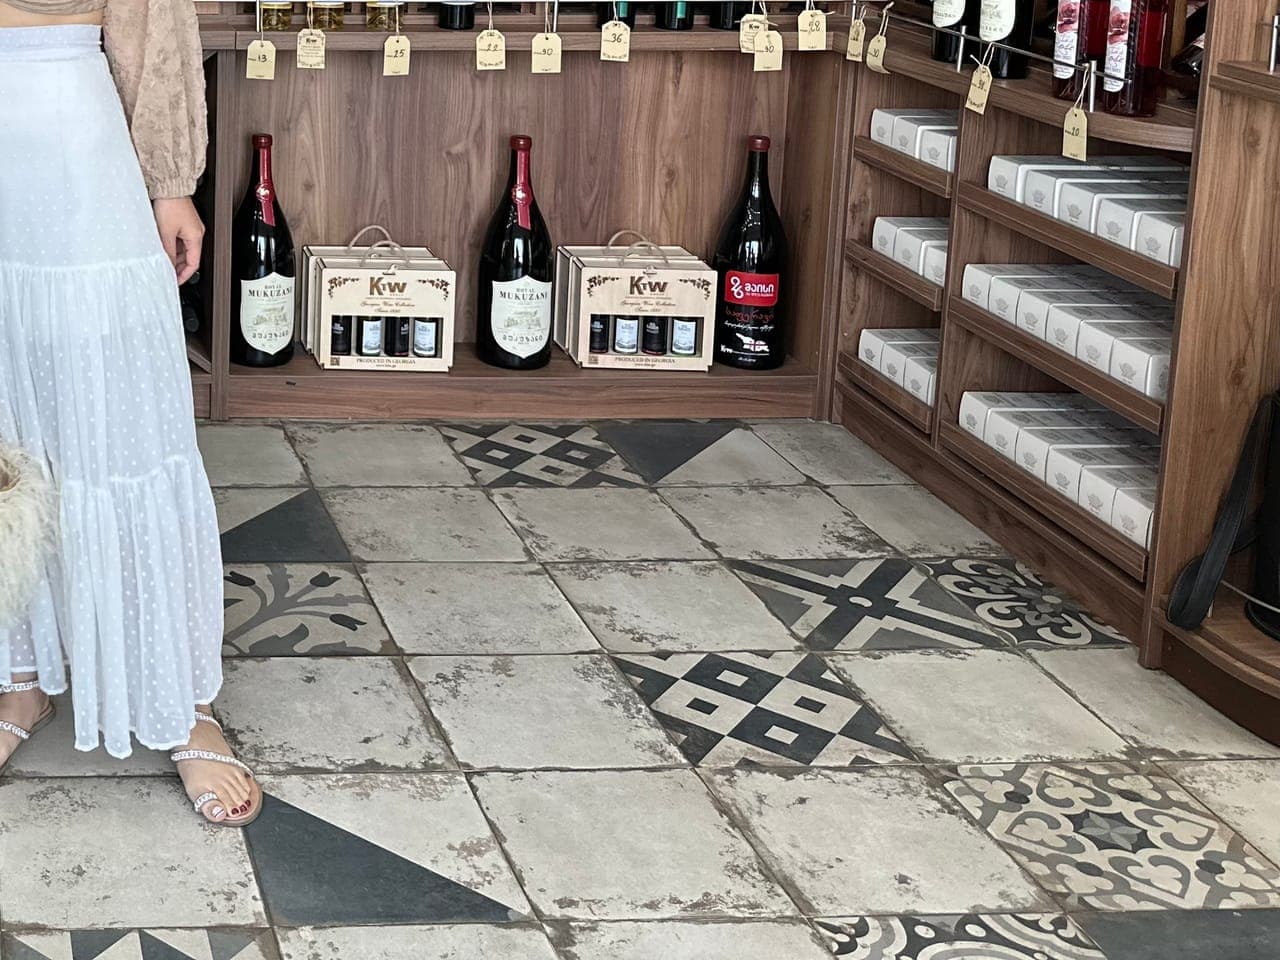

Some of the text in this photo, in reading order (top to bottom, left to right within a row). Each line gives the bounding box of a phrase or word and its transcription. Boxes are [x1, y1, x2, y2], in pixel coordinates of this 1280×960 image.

[611, 33, 623, 43] 36
[369, 276, 407, 296] KTW
[629, 276, 669, 295] KTW
[499, 290, 548, 301] MUKUZANI
